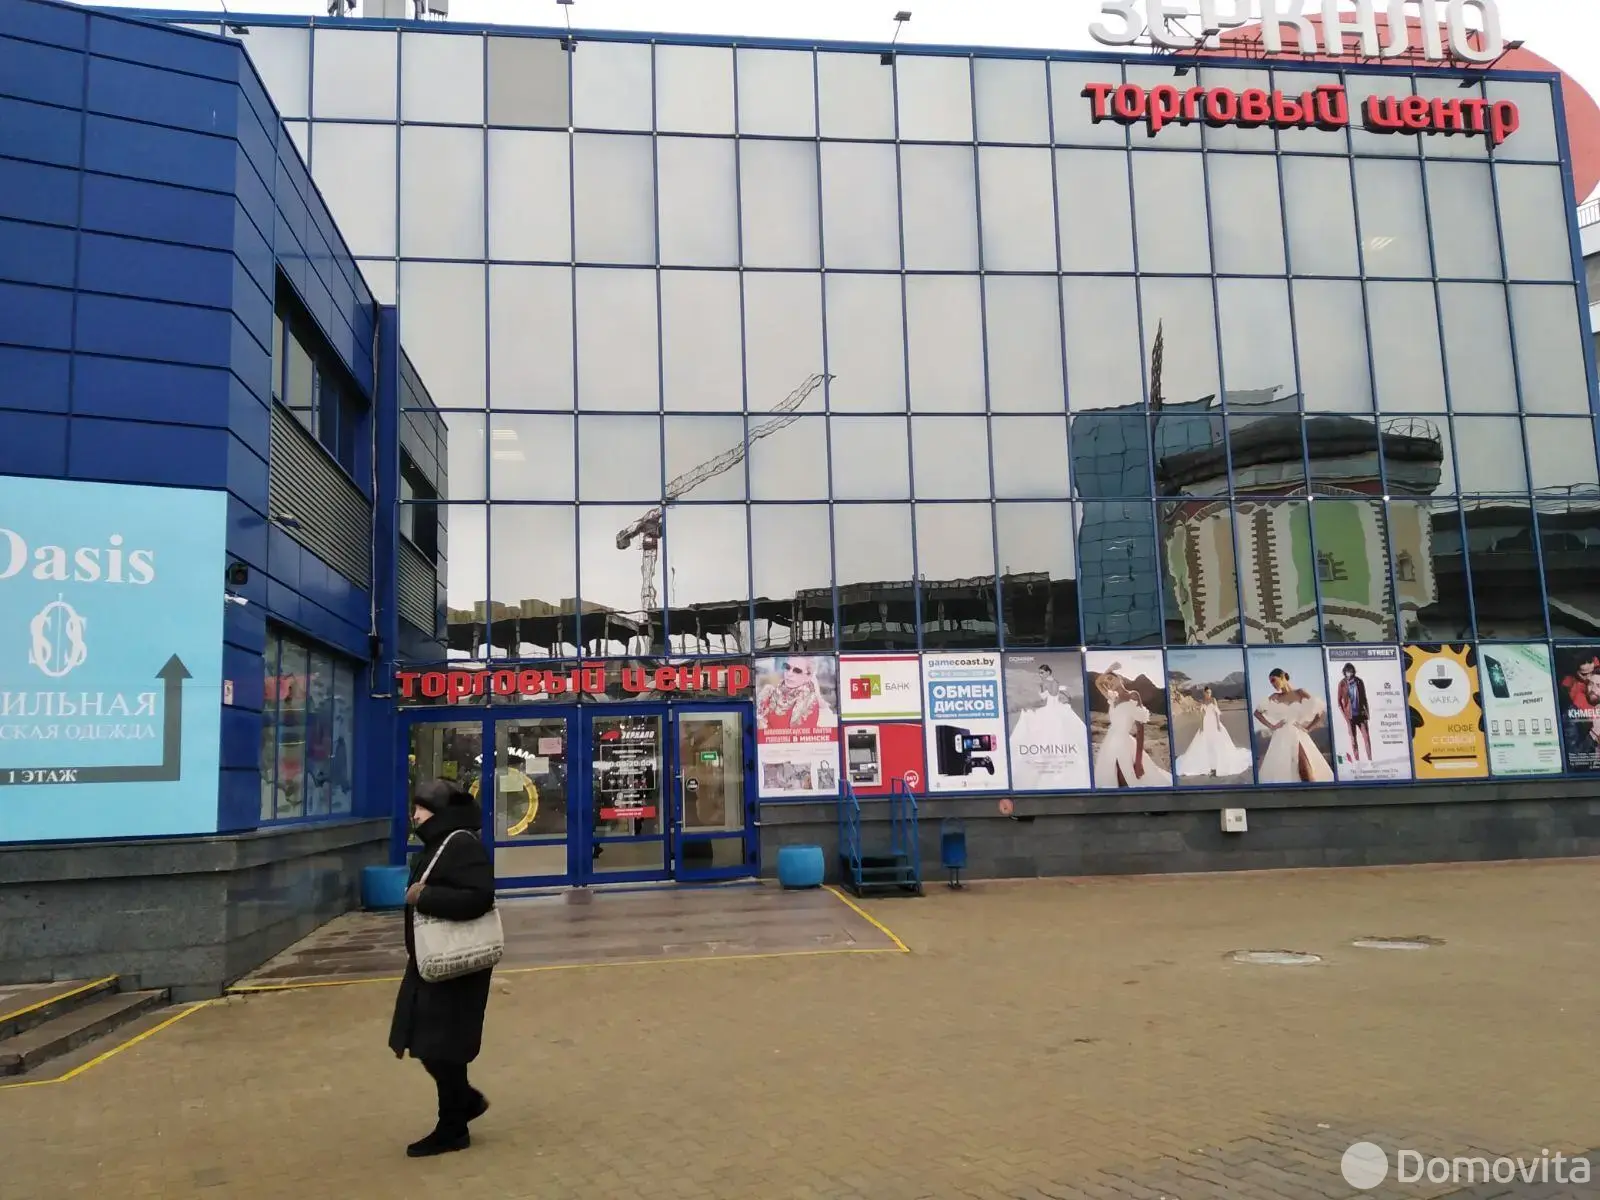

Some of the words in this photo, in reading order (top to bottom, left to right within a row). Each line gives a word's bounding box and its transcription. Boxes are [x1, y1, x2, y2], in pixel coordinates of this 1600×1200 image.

[1082, 82, 1350, 137] торговый
[1364, 95, 1521, 148] центр
[1367, 649, 1395, 657] STREET
[928, 657, 995, 668] gamecoast.by
[396, 661, 606, 705] торговый
[621, 664, 751, 697] центр
[885, 682, 910, 691] БАНК
[932, 684, 994, 699] ОБМЕН
[934, 700, 995, 713] ДИСКОВ
[65, 724, 157, 741] ОДЕЖДА
[1447, 723, 1474, 733] КОФЕ
[1019, 744, 1078, 755] DOMINIK
[8, 771, 15, 784] 1
[21, 769, 79, 784] ЭТАЖ
